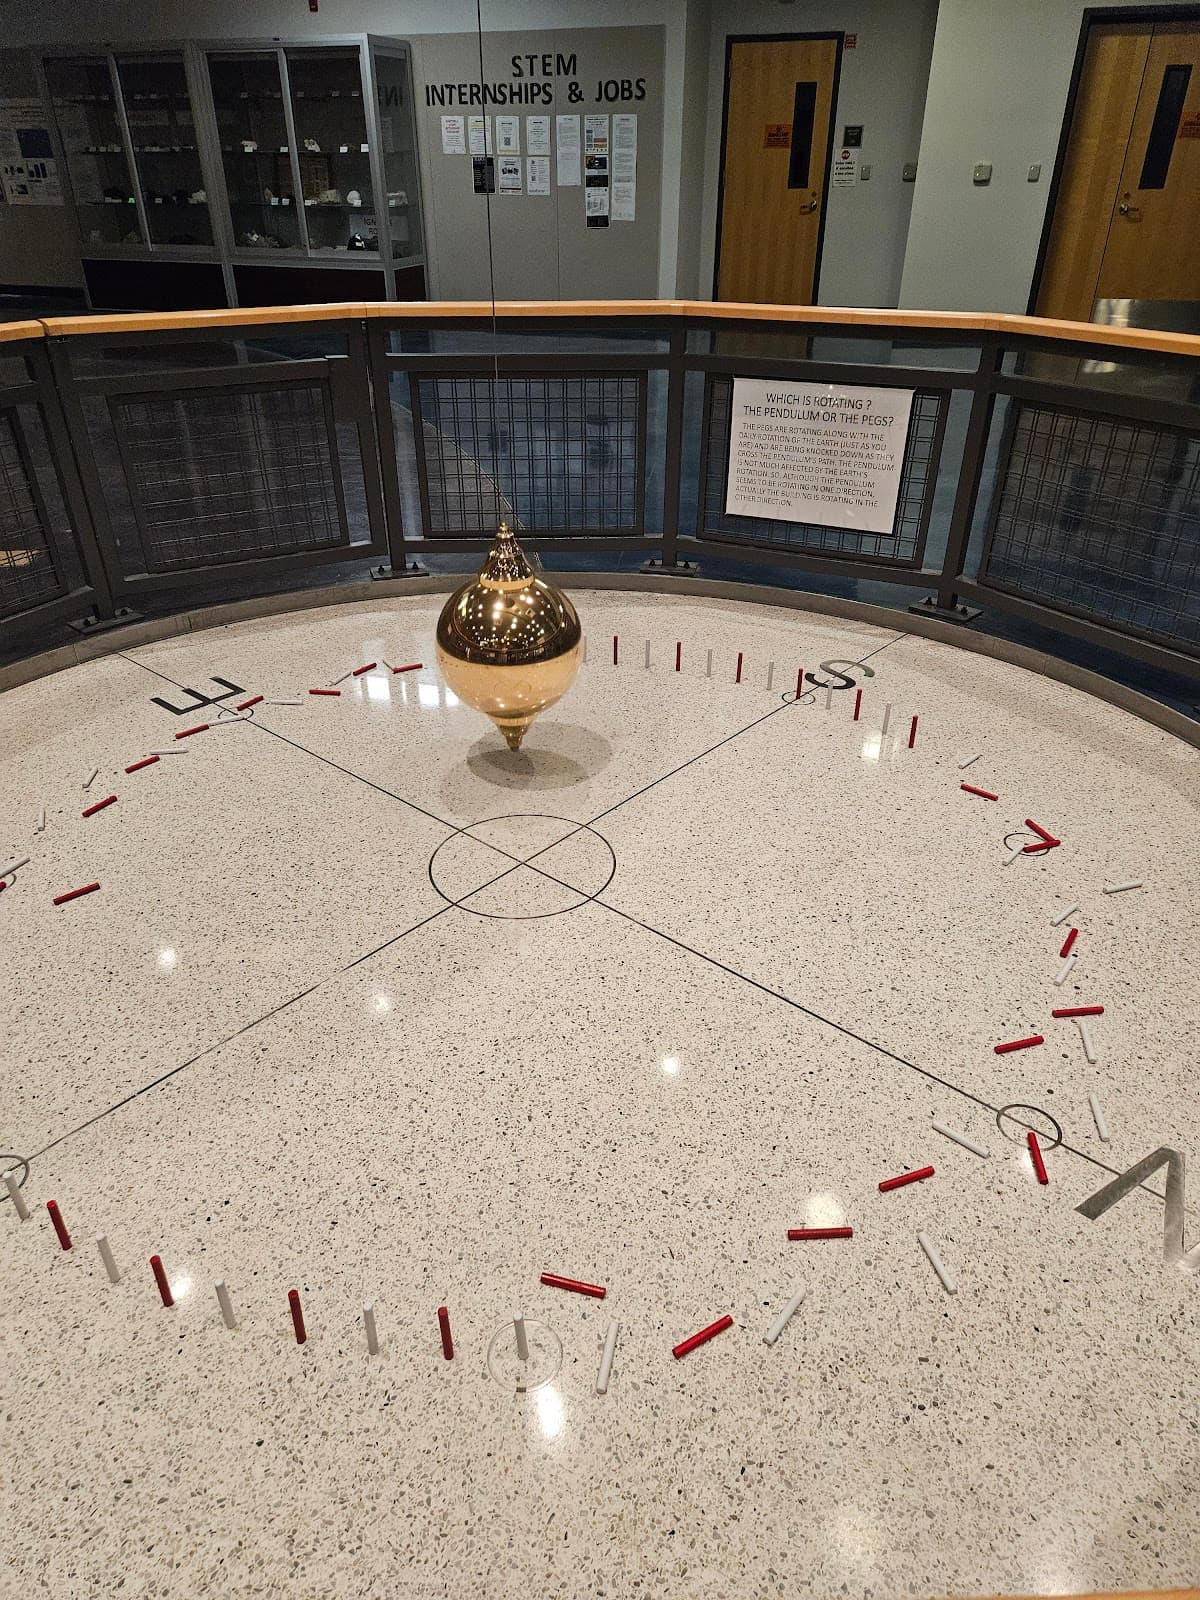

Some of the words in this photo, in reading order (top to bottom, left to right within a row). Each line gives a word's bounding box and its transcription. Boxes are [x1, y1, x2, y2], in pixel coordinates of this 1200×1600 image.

[511, 54, 577, 77] STEM
[425, 82, 553, 106] INTERNSHIPS
[568, 82, 584, 103] &
[595, 78, 646, 102] JOBS
[767, 393, 799, 405] WHICH
[803, 396, 810, 406] IS
[814, 397, 862, 409] ROTATING
[744, 406, 761, 416] THE
[765, 408, 819, 421] PENDULUM
[823, 412, 836, 422] OR
[840, 413, 858, 424] THE
[862, 415, 894, 427] PEGS?
[790, 427, 822, 436] ROTATING
[823, 430, 847, 438] ALONG
[758, 434, 789, 443] ROTATION
[817, 439, 839, 447] EARTH
[872, 443, 886, 451] YOU
[785, 445, 804, 454] BEING
[806, 447, 838, 457] KNOCKED
[841, 451, 863, 459] DOWN
[781, 464, 813, 473] AFFECTED
[854, 461, 894, 471] PENDULUM
[736, 477, 756, 485] SEEMS
[778, 481, 809, 490] ROTATING
[811, 484, 818, 492] IN
[783, 473, 818, 482] ALTHOUGH
[836, 478, 875, 488] PENDULUM
[736, 486, 765, 494] ACTUALLY
[781, 490, 812, 499] BUILDING
[822, 495, 853, 504] ROTATING
[865, 499, 878, 507] THE
[805, 659, 875, 690] S
[150, 676, 246, 715] E
